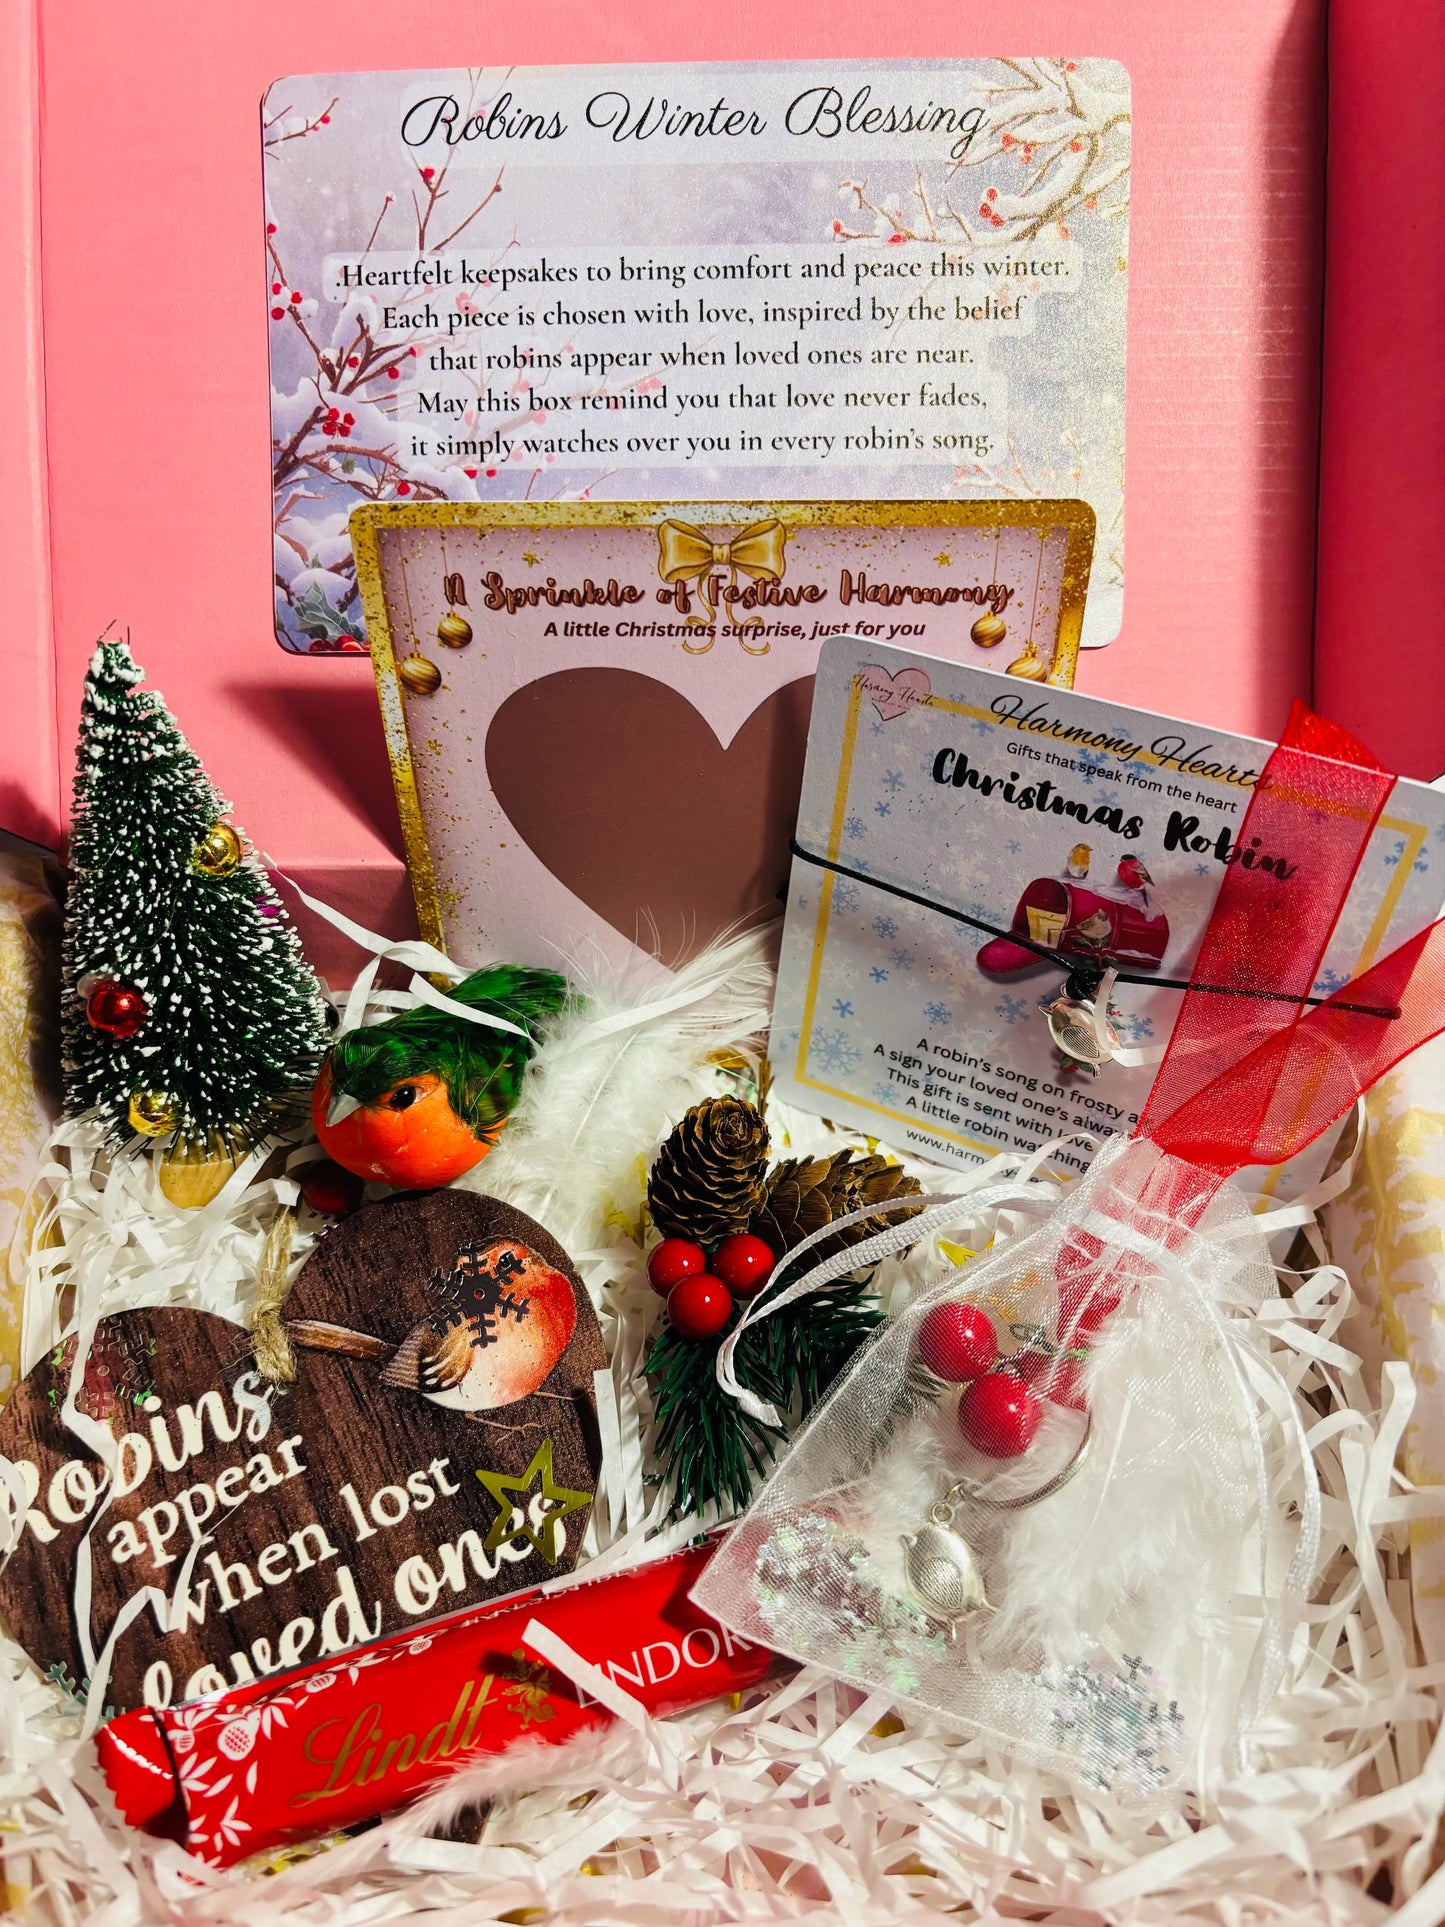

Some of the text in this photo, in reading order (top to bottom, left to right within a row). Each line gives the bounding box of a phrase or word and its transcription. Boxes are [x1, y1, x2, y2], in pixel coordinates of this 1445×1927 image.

[402, 85, 990, 158] Robins Winter Blessing
[461, 257, 579, 291] keepsakes
[587, 263, 611, 282] to
[619, 257, 686, 288] bring
[693, 255, 792, 279] comfort
[801, 253, 846, 278] and
[855, 260, 922, 285] peace
[931, 252, 975, 276] this
[983, 256, 1070, 276] winter.
[383, 295, 1027, 335] Each piece is chosen with love, inspired by the belief
[430, 341, 974, 375] that robins appear when loved ones are near.
[418, 382, 988, 421] May this box remind you that love never fades,
[411, 425, 994, 461] it simply watches over you in every robin’s song.
[481, 571, 645, 615] Sprinkle
[656, 579, 695, 614] of
[707, 574, 828, 610] Festive
[839, 568, 1014, 614] Harmony
[543, 620, 926, 640] A little Christmas surprise, just for you
[990, 694, 1142, 761] Harmony
[1007, 742, 1238, 813] Gifts that speak from the heart
[932, 748, 1298, 880] Christmas Robin
[873, 1043, 885, 1056] A
[889, 1051, 922, 1069] sign
[925, 1064, 966, 1083] your
[970, 1075, 1018, 1103] loved
[1022, 1097, 1068, 1121] one’s
[1073, 1116, 1133, 1140] alwa
[887, 1067, 919, 1089] This
[922, 1084, 952, 1101] gift
[956, 1092, 969, 1107] is
[973, 1101, 1011, 1122] sent
[1015, 1117, 1052, 1137] with
[917, 1038, 1125, 1120] A robin’s song on frosty
[906, 1096, 917, 1109] A
[921, 1101, 960, 1124] little
[964, 1119, 1008, 1142] robin
[107, 1434, 306, 1568] appear
[340, 1455, 461, 1542] lost
[290, 1674, 499, 1808] Lindt
